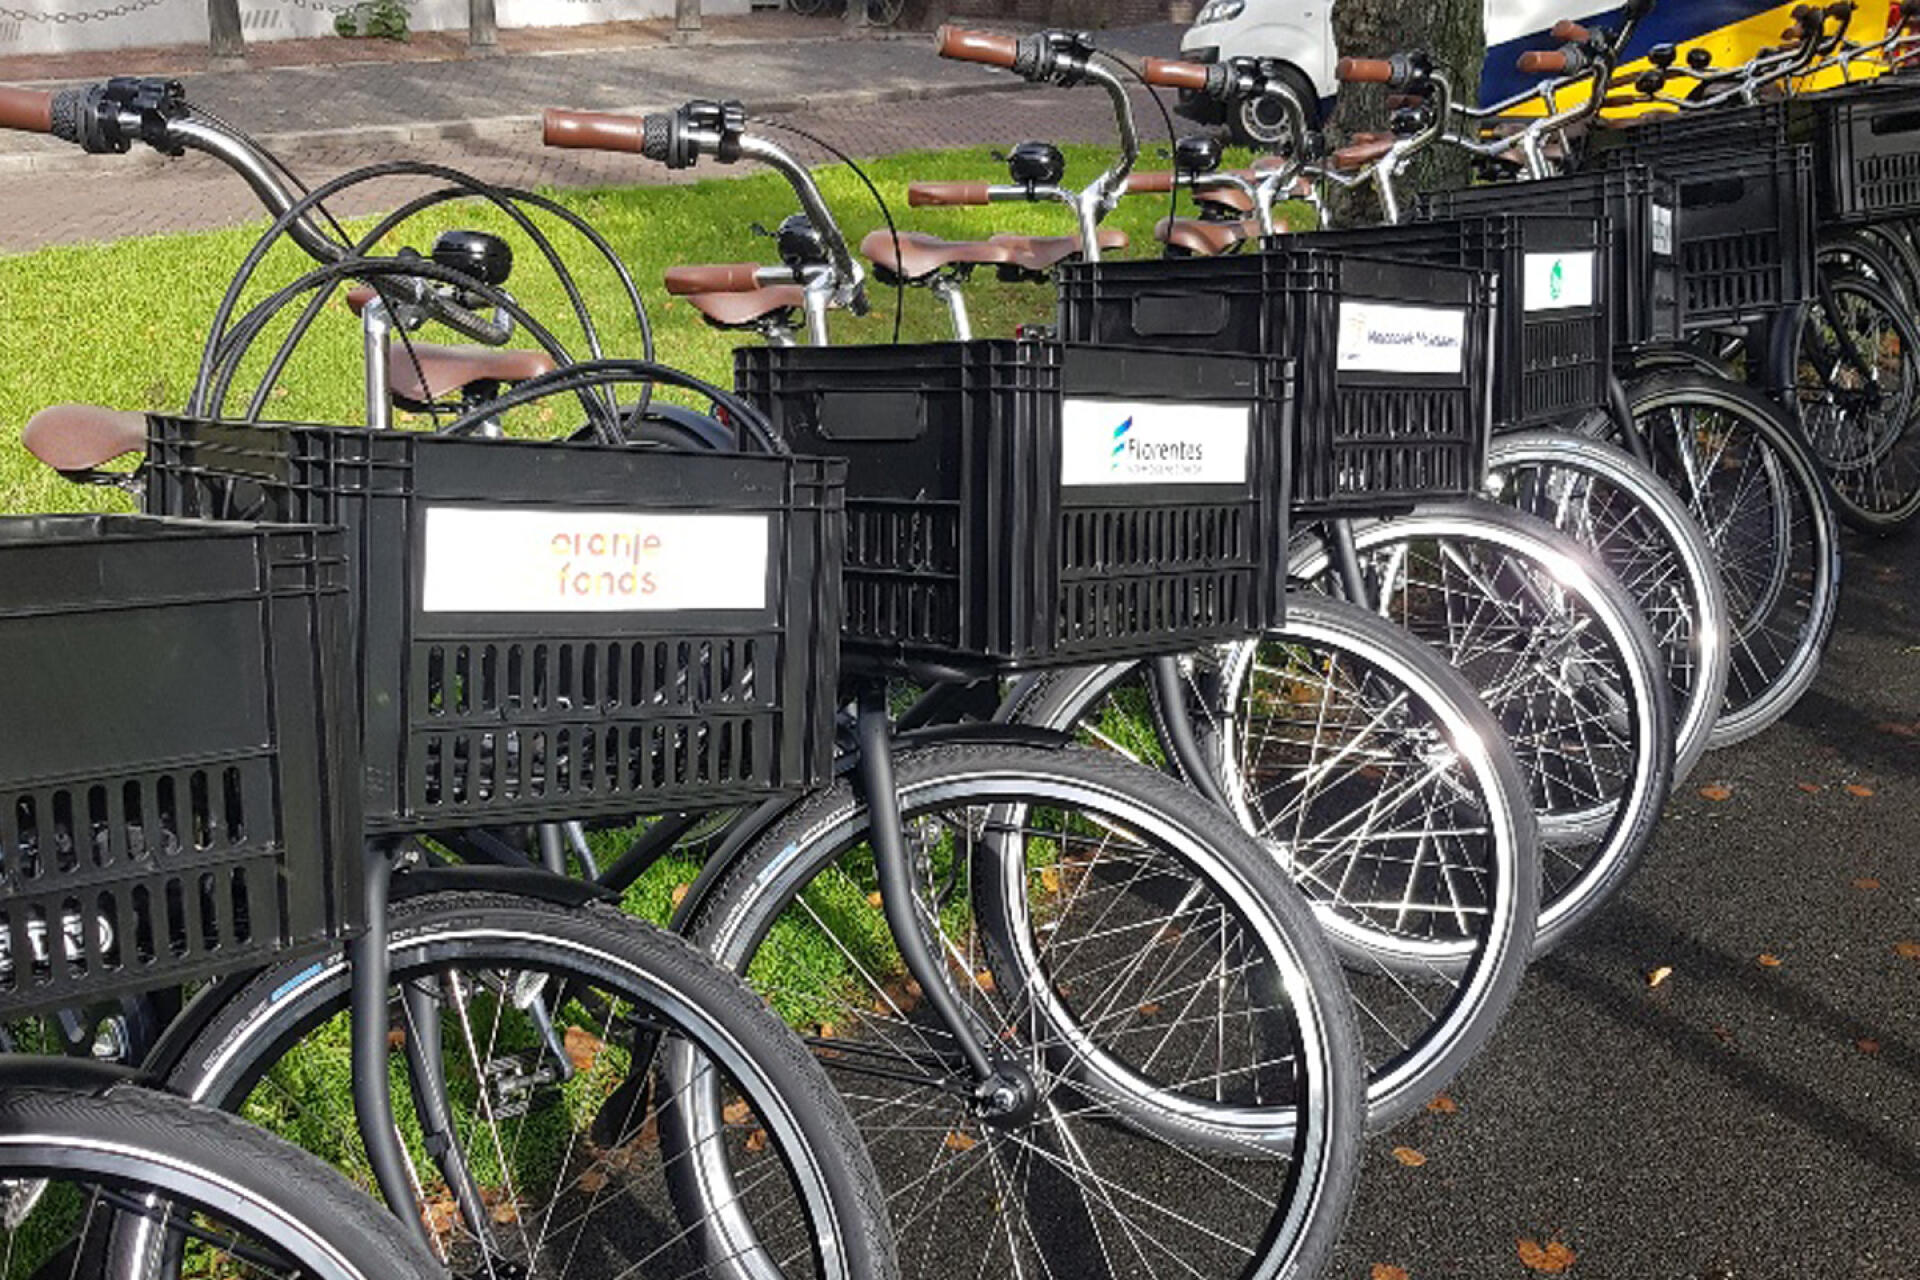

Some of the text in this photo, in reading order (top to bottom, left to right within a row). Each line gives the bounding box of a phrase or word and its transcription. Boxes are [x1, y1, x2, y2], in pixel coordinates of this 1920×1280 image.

[1129, 438, 1202, 460] Florentes
[551, 530, 661, 565] oranje
[558, 561, 658, 595] fonds
